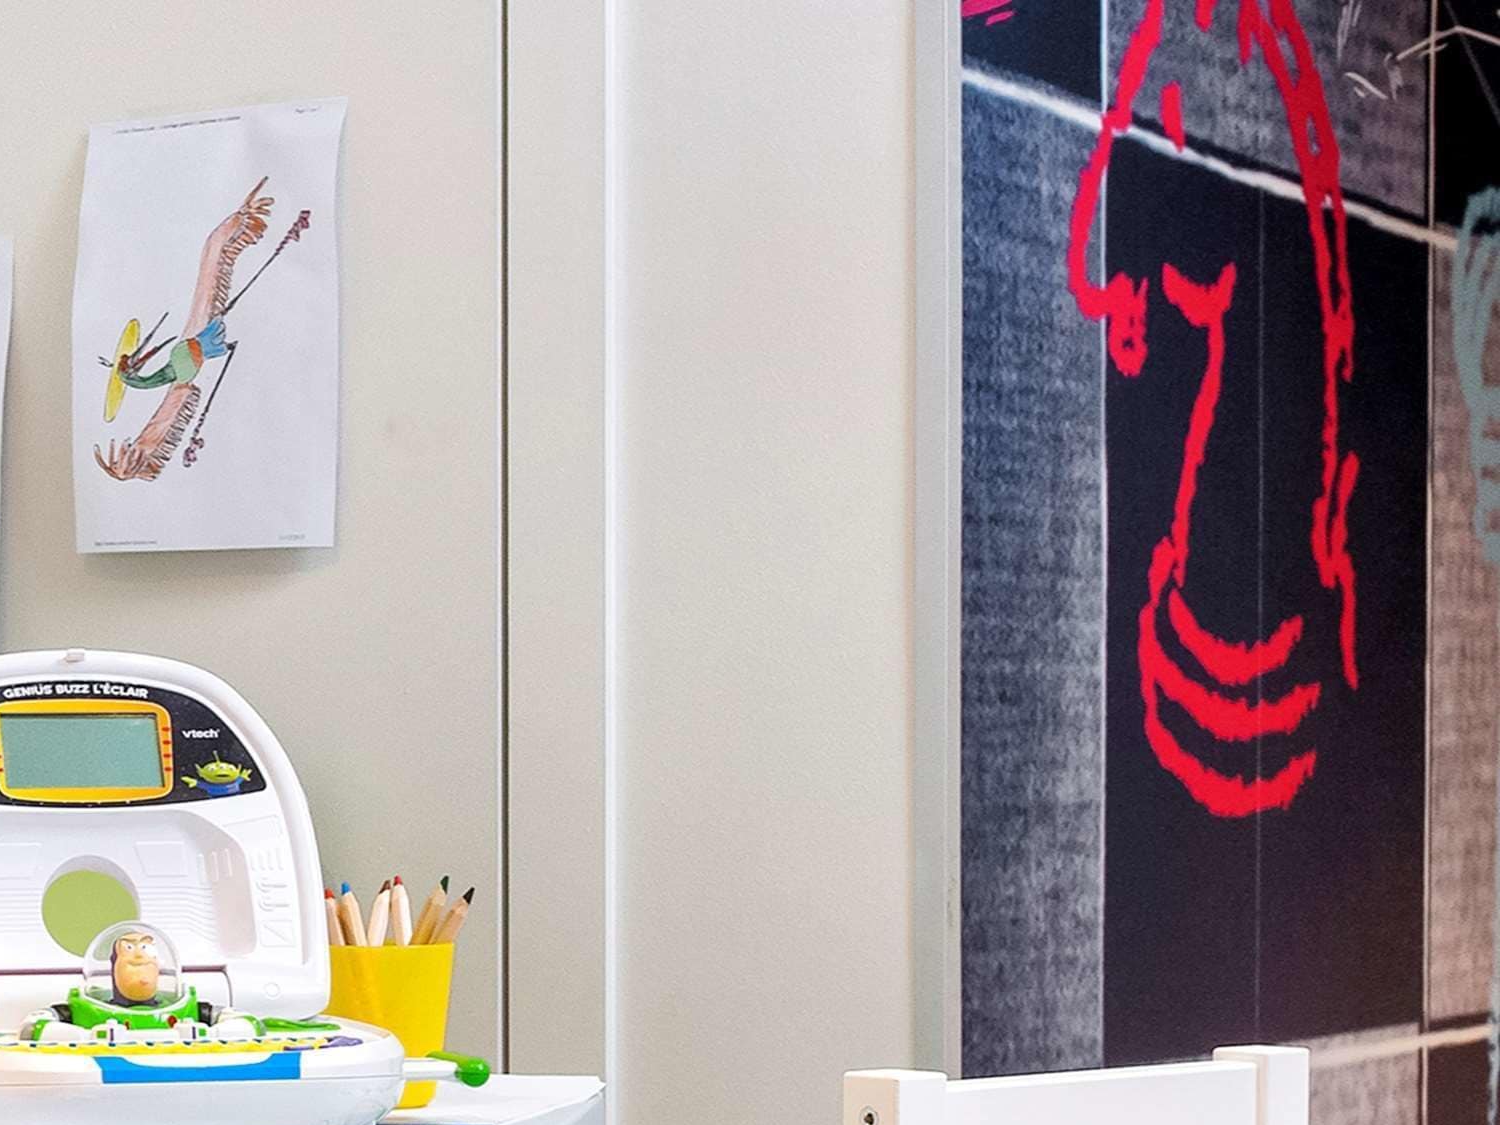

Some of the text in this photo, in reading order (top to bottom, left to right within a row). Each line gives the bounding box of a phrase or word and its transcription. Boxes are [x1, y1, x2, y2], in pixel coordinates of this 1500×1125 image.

[3, 682, 148, 698] GENIUS BUZZ L'ÉCLAIR
[182, 728, 221, 739] vtech
